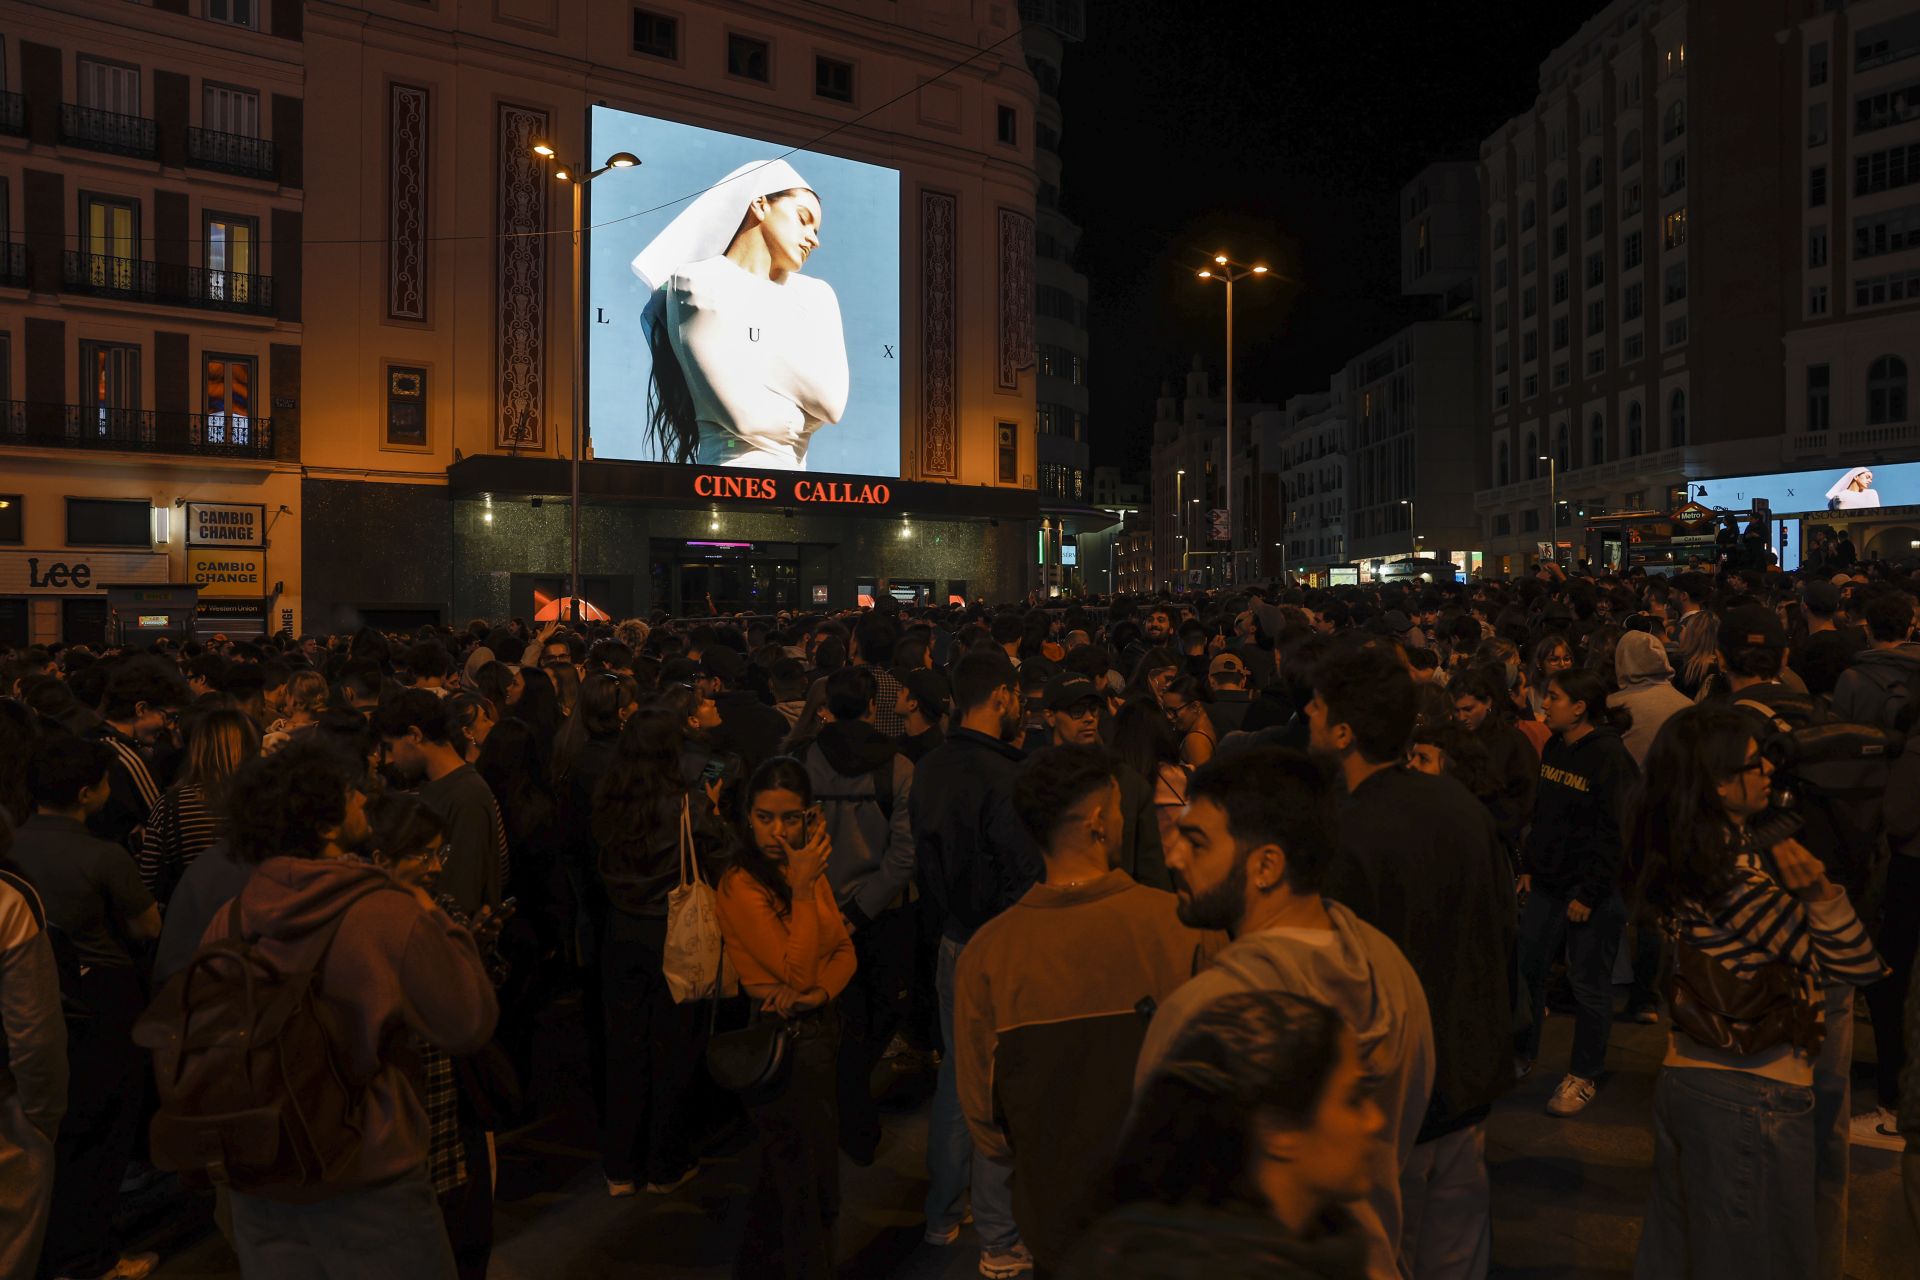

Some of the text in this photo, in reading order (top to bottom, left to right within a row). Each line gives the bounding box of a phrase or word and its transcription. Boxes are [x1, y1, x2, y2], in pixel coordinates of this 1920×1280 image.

[597, 307, 894, 359] L U X
[694, 474, 891, 505] CINES CALLAO
[1787, 488, 1794, 497] X
[199, 510, 254, 526] CAMBIO
[1681, 512, 1701, 520] Metro
[199, 525, 254, 540] CHANGE
[28, 558, 91, 588] Lee
[196, 561, 256, 573] CAMBIO
[195, 573, 257, 583] CHANGE
